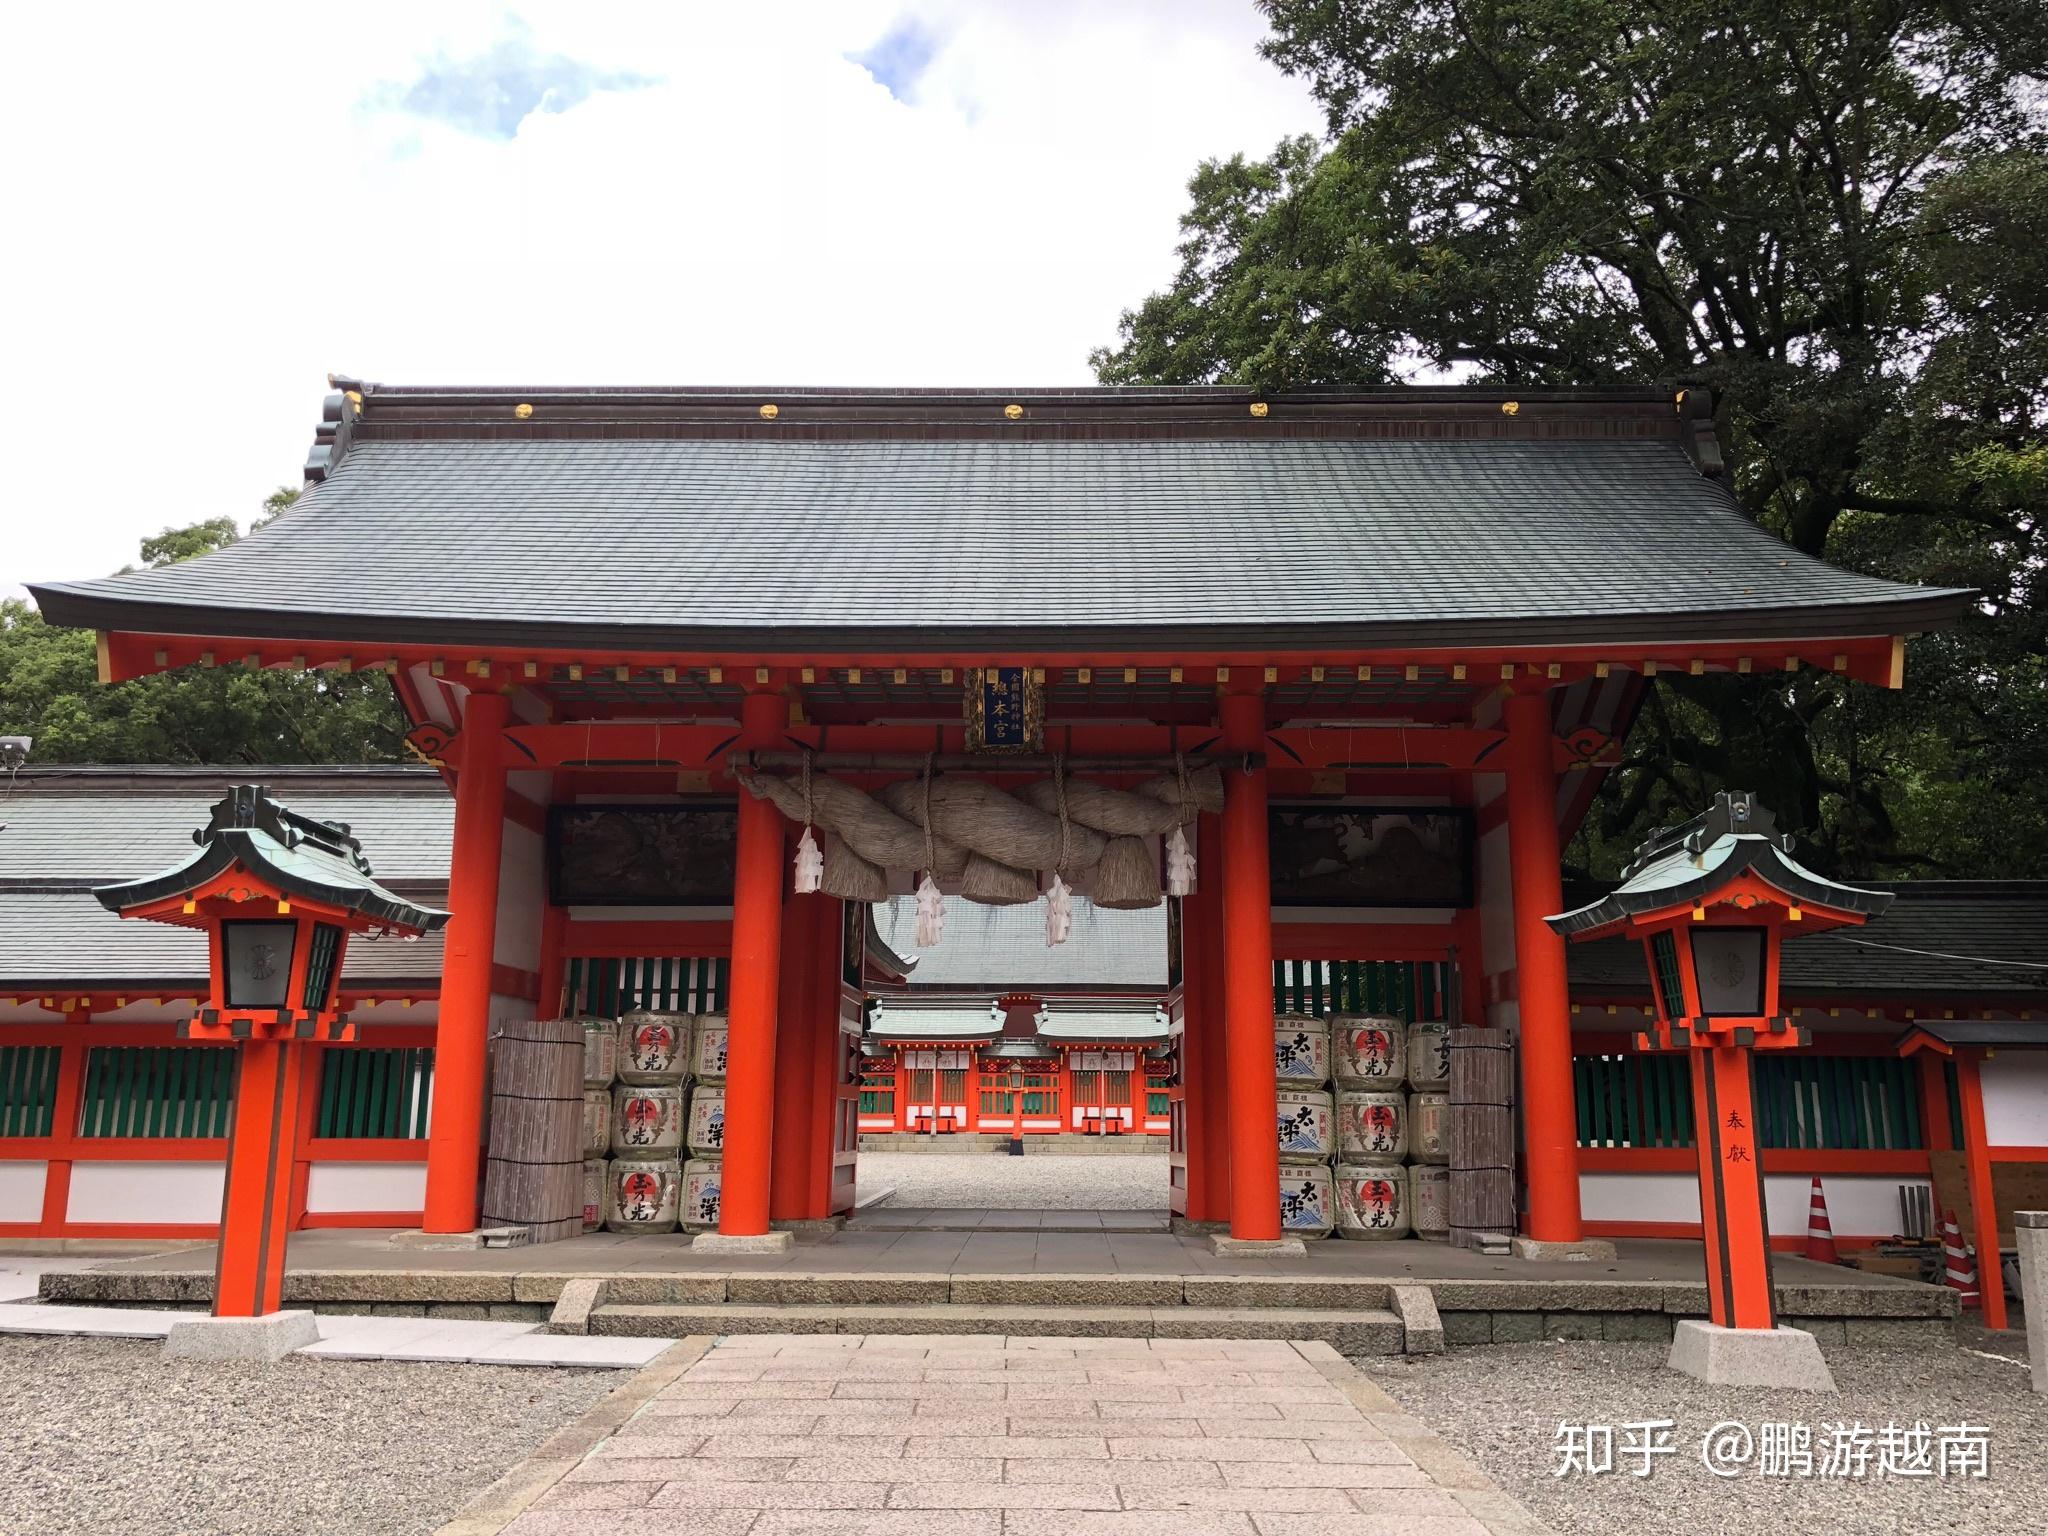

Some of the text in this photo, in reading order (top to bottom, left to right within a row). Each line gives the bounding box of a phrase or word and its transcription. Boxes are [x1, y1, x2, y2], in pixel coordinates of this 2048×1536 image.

[643, 1022, 667, 1071] 玉乃光
[1364, 1029, 1384, 1076] 玉乃光
[628, 1098, 653, 1145] 玉乃光
[1371, 1105, 1390, 1152] 玉乃光
[1726, 1110, 1751, 1163] 奉獻
[626, 1173, 652, 1221] 玉乃光
[700, 1195, 722, 1223] 洋
[1370, 1180, 1389, 1228] 玉乃光
